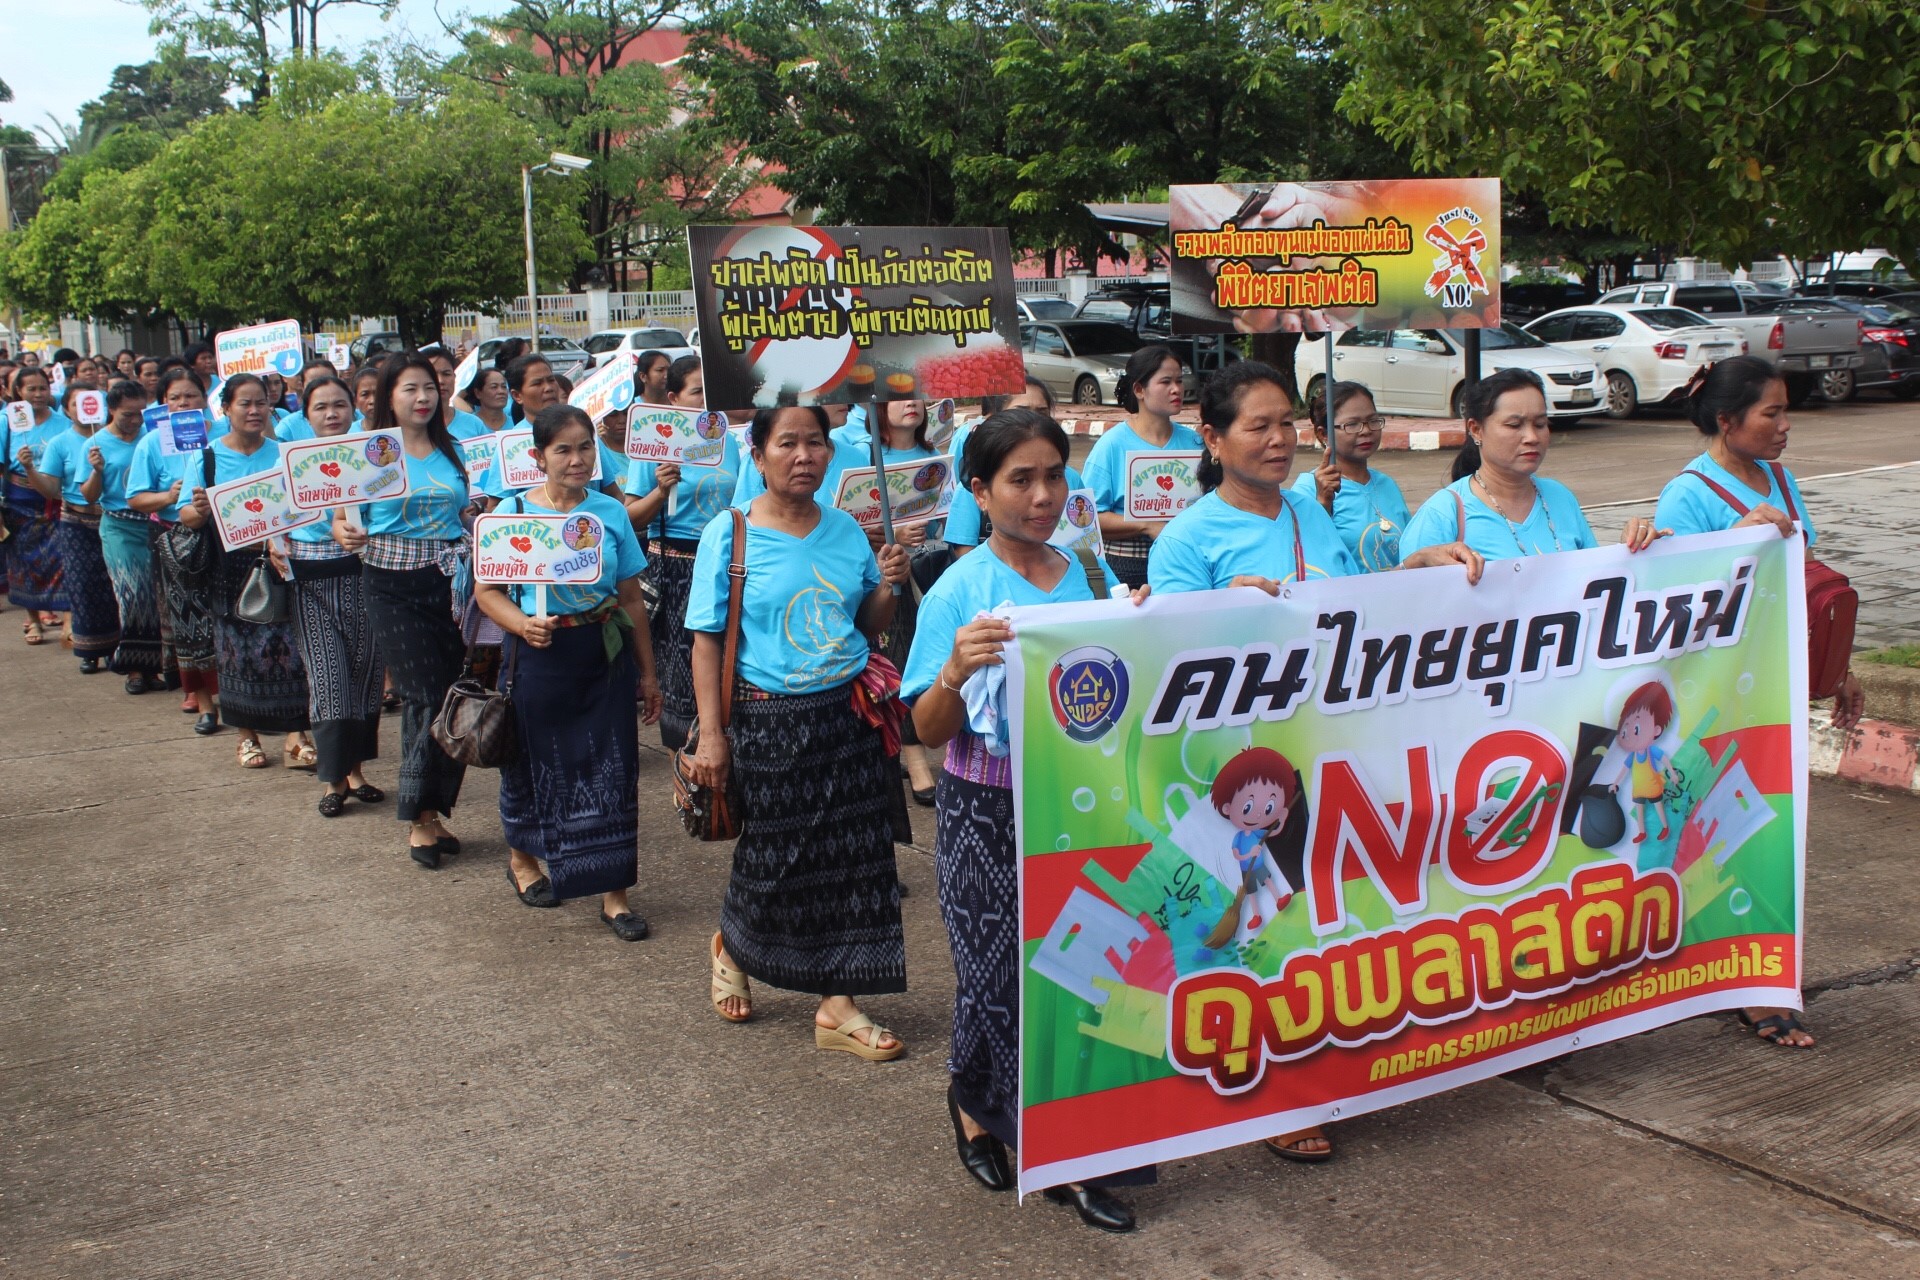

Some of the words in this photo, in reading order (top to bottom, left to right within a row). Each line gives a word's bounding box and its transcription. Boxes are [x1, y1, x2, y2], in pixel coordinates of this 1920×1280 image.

[1438, 207, 1460, 225] Just
[1463, 207, 1481, 224] Say
[1175, 217, 1411, 265] รวมพลังกองทุนแม่ของแผ่นดิน
[711, 249, 827, 287] ยาเสพติด
[1216, 259, 1377, 307] พิชิตยาเสพติด
[1443, 284, 1473, 306] NO!
[721, 299, 838, 350] ผู้เสพตาย
[850, 297, 992, 347] ผู้ขายติดทุกข์
[553, 551, 599, 577] รณชัย
[1150, 565, 1753, 725] คนไทยยุคใหม่
[1310, 730, 1567, 926] NO
[1184, 876, 1671, 1076] ถุงพลาสติก
[1369, 942, 1783, 1082] คณะกรรมการพัฒนาสตรีอำเภอเฝ้าไร่
